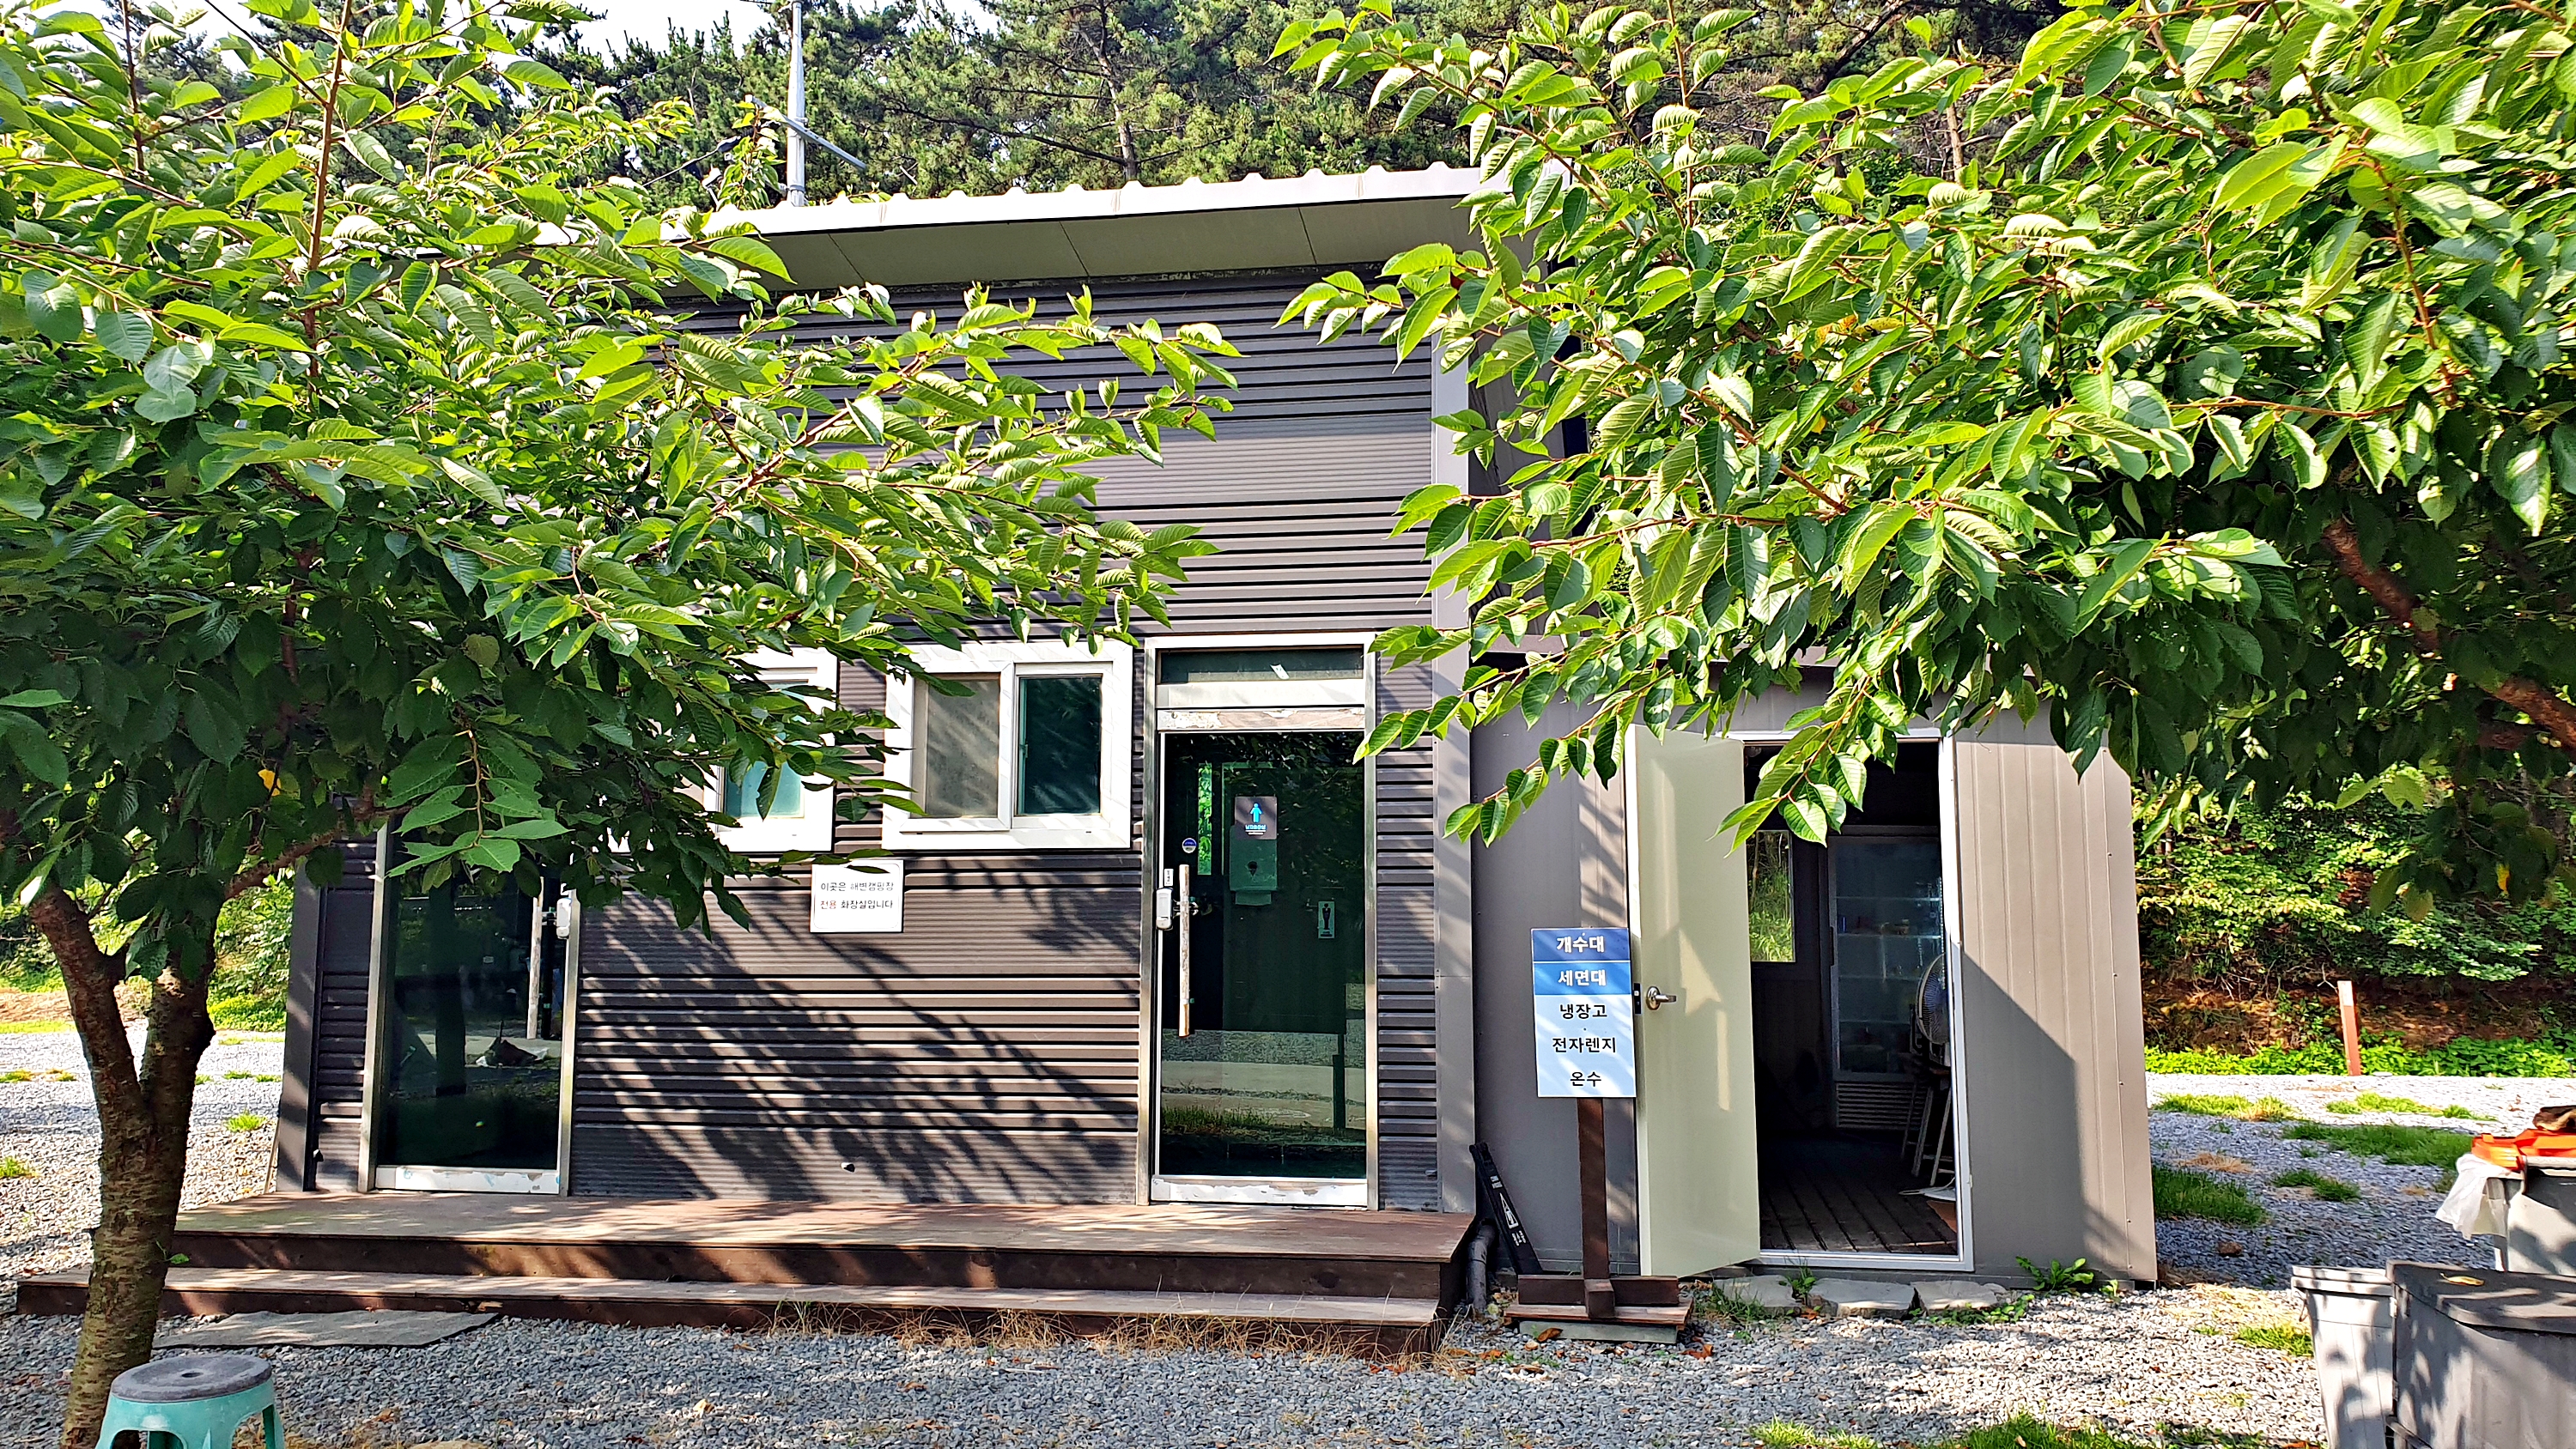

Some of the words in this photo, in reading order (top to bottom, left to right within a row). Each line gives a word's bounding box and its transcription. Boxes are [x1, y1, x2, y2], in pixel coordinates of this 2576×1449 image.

[820, 882, 847, 892] 이곳은
[820, 900, 836, 910] 전용
[841, 900, 893, 910] 화장실입니다
[1557, 936, 1605, 954] 개수대
[1558, 969, 1607, 986] 세면대
[1559, 1003, 1607, 1020] 냉장고
[1552, 1037, 1616, 1053] 전자렌지
[1570, 1071, 1602, 1088] 온수
